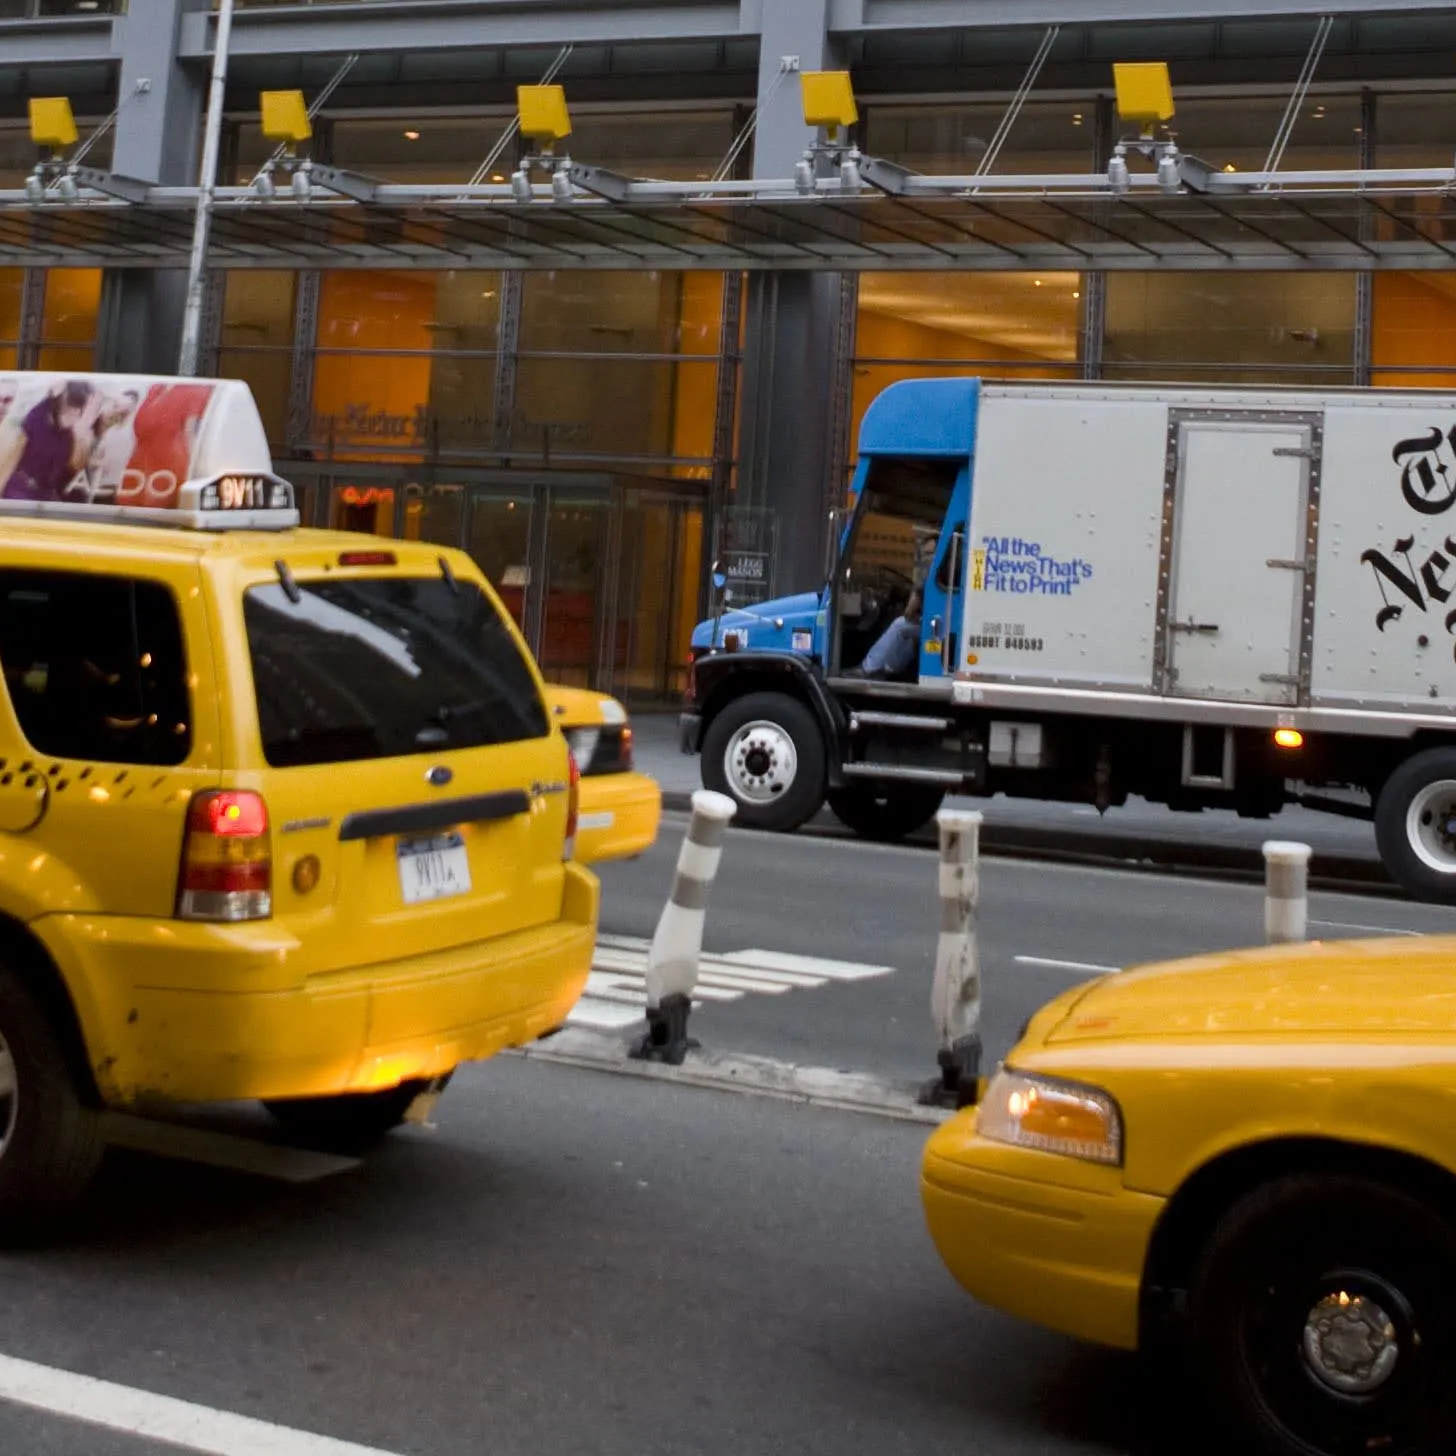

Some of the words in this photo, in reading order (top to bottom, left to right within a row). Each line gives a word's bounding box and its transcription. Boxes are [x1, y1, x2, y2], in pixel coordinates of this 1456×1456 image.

[64, 468, 178, 498] ALDO
[1011, 537, 1041, 557] the
[984, 555, 1037, 574] News
[1037, 556, 1093, 578] That's
[983, 573, 1008, 593] Fit
[1009, 575, 1028, 594] to
